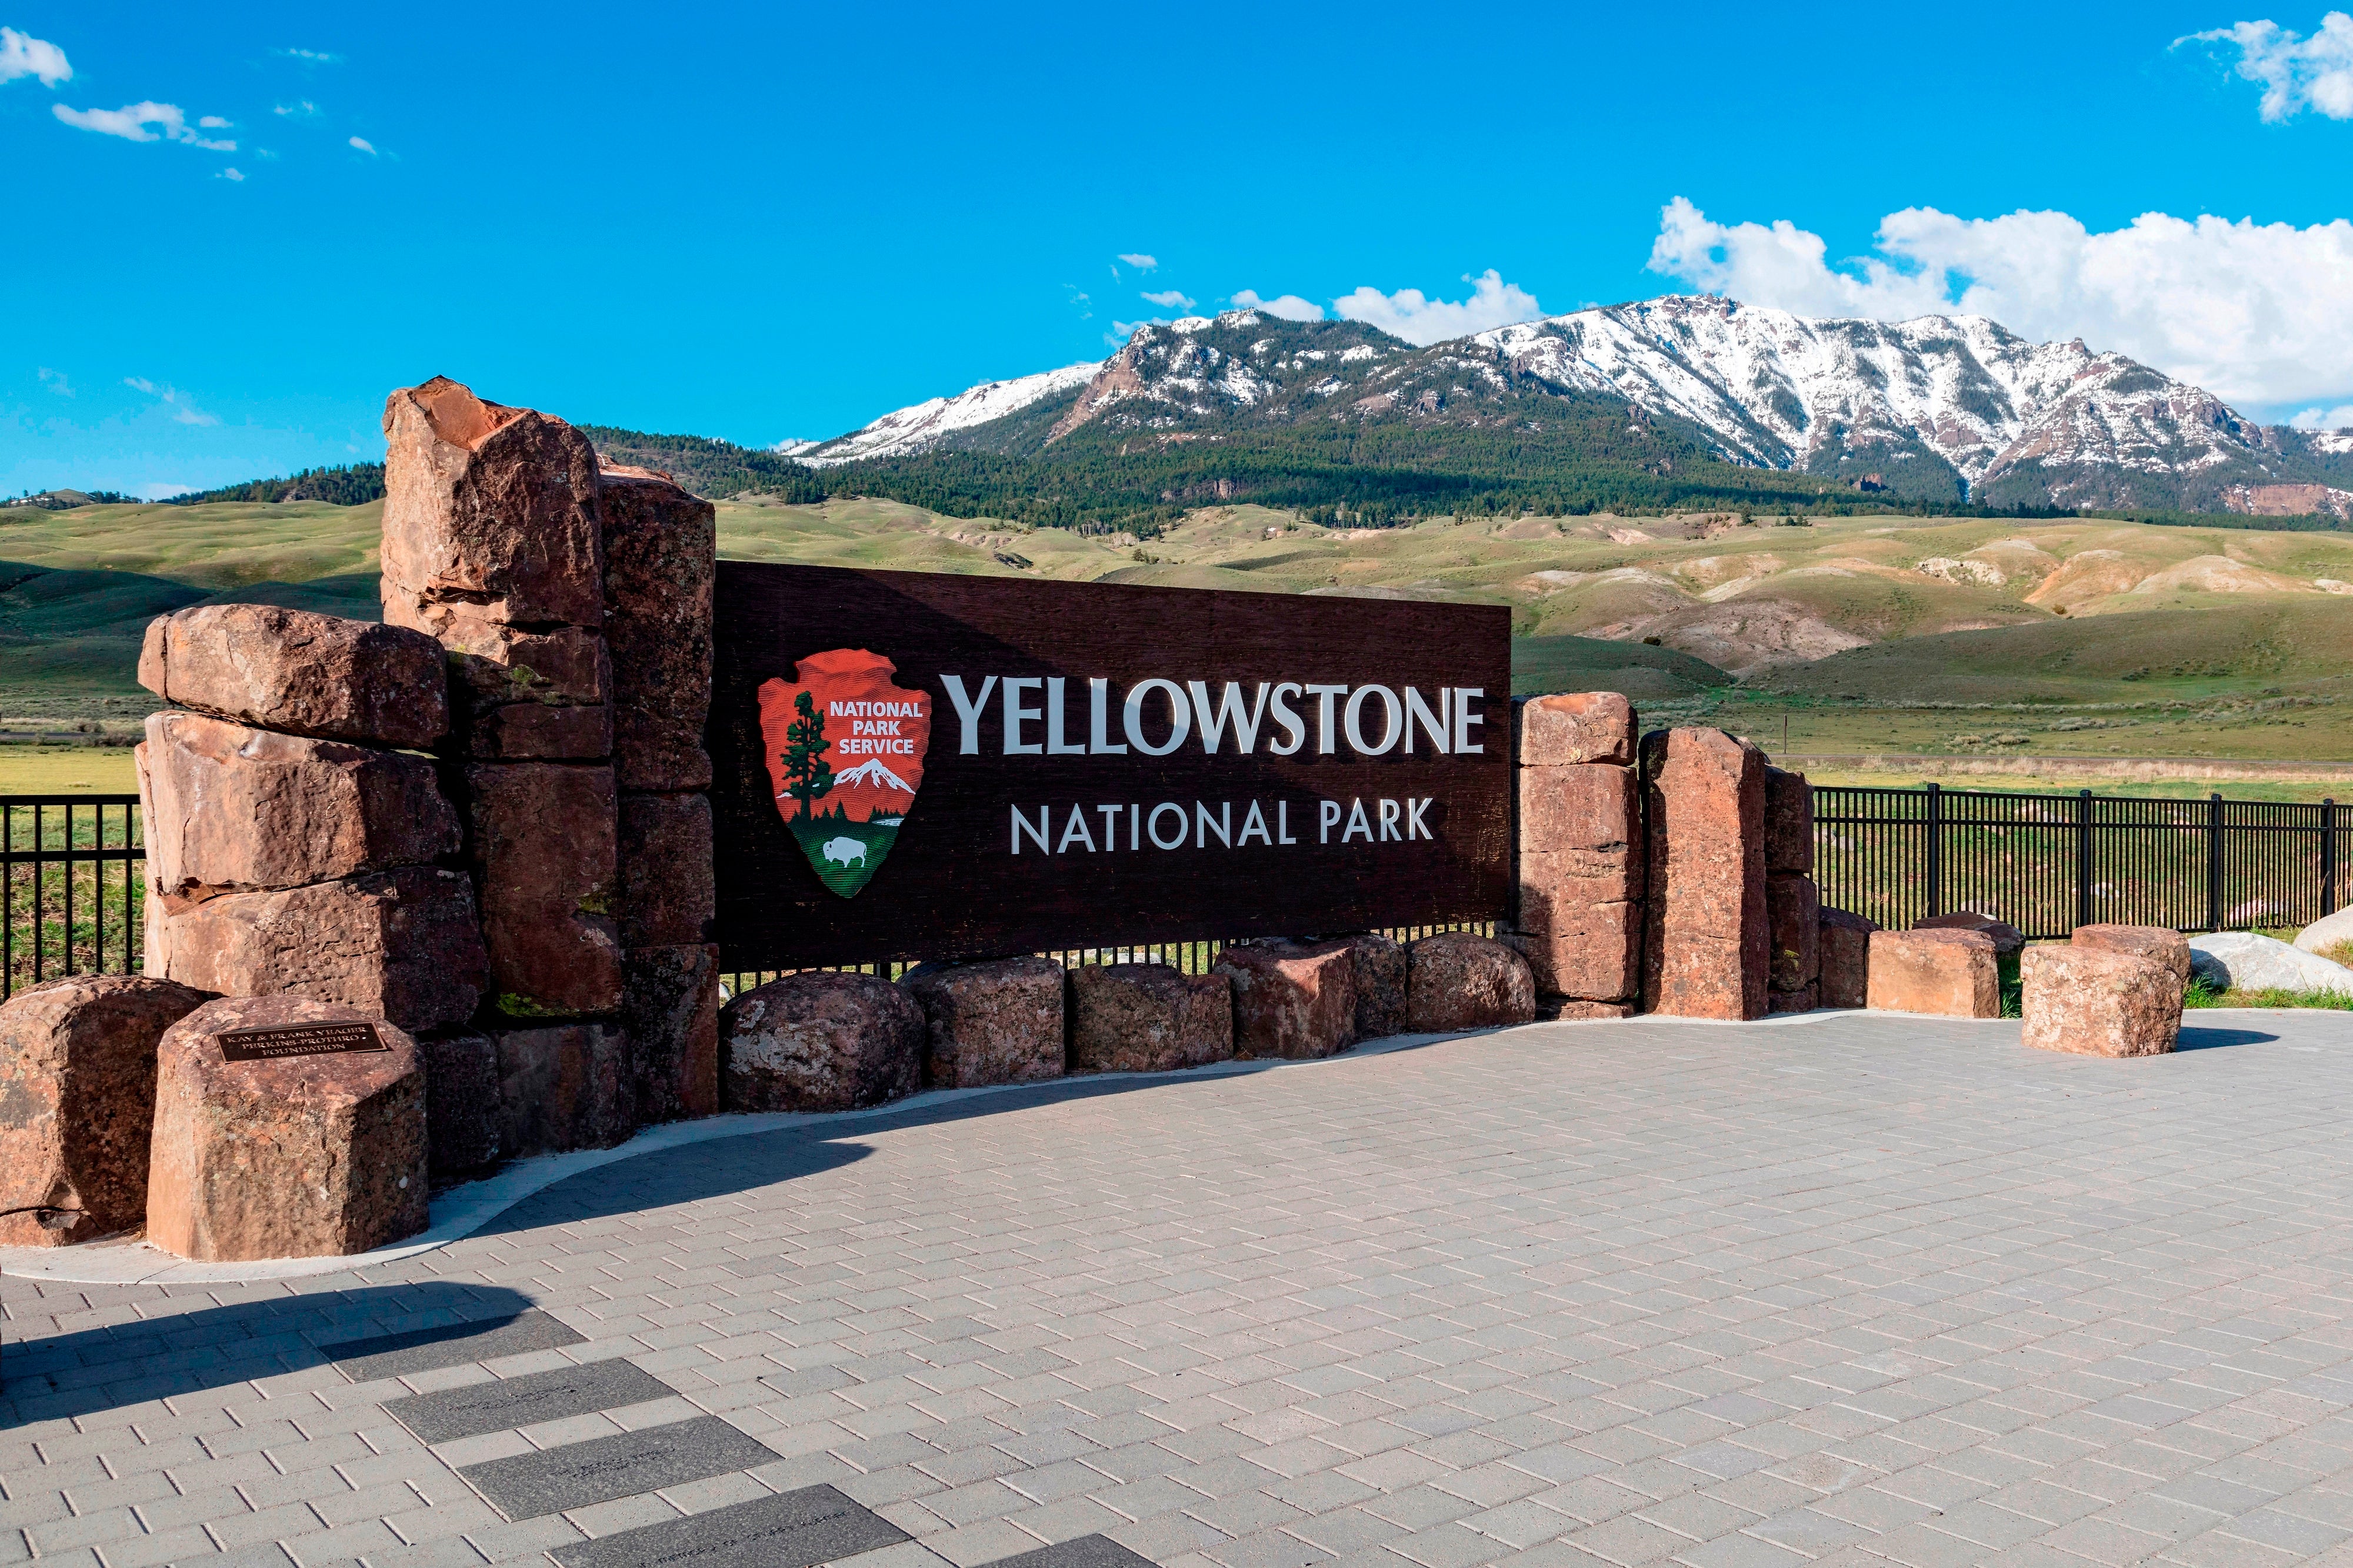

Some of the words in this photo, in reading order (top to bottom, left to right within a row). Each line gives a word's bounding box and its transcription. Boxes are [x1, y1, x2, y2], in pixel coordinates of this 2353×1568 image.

[831, 702, 923, 717] NATIONAL
[939, 674, 1484, 755] YELLOWSTONE
[853, 720, 901, 736] PARK
[839, 739, 914, 754] SERVICE
[1011, 799, 1297, 855] NATIONAL
[1320, 798, 1434, 843] PARK
[269, 1031, 315, 1040] FRANK
[316, 1027, 366, 1036] YEAGER
[241, 1035, 359, 1050] PERKINS-PROTHRO
[262, 1043, 346, 1056] FOUNDATION
